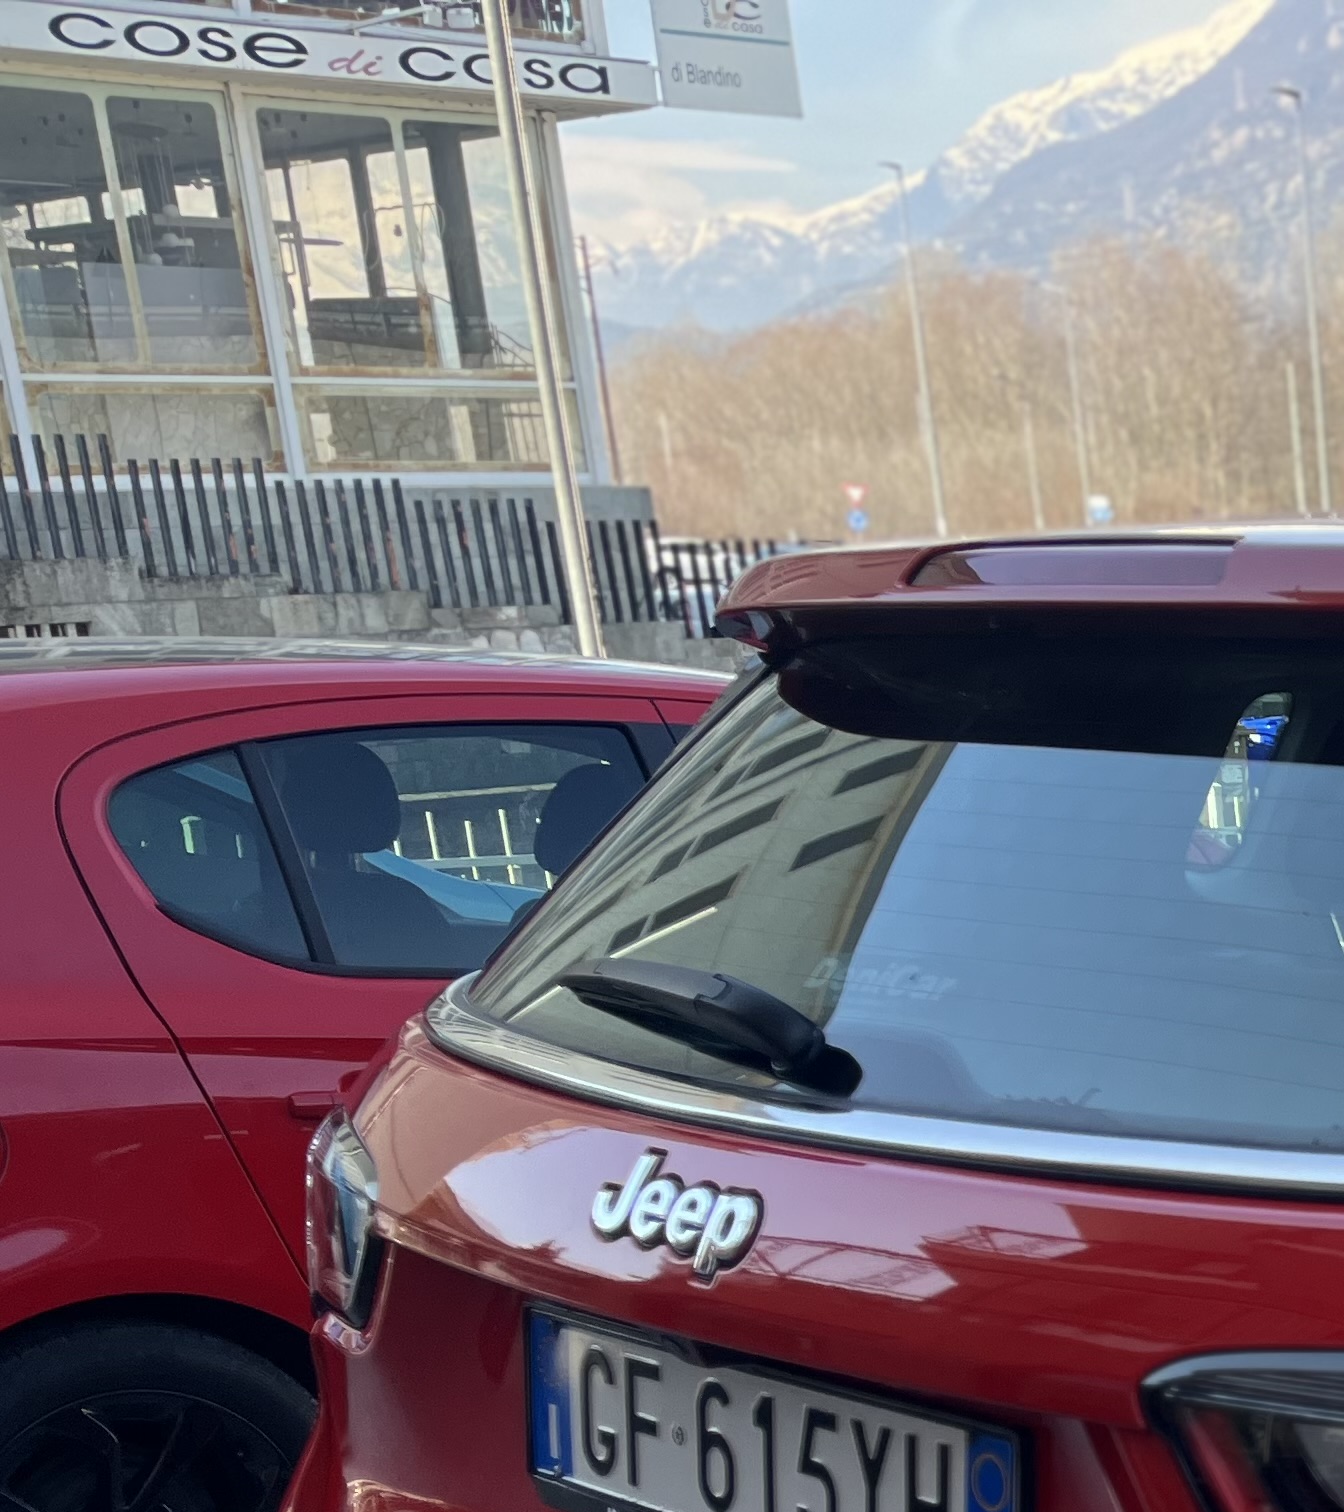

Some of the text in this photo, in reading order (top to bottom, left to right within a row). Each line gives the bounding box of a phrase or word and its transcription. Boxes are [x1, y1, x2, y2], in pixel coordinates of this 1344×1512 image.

[47, 12, 611, 95] cose di casa
[671, 61, 742, 88] di Blandino
[590, 1146, 764, 1284] Jeep
